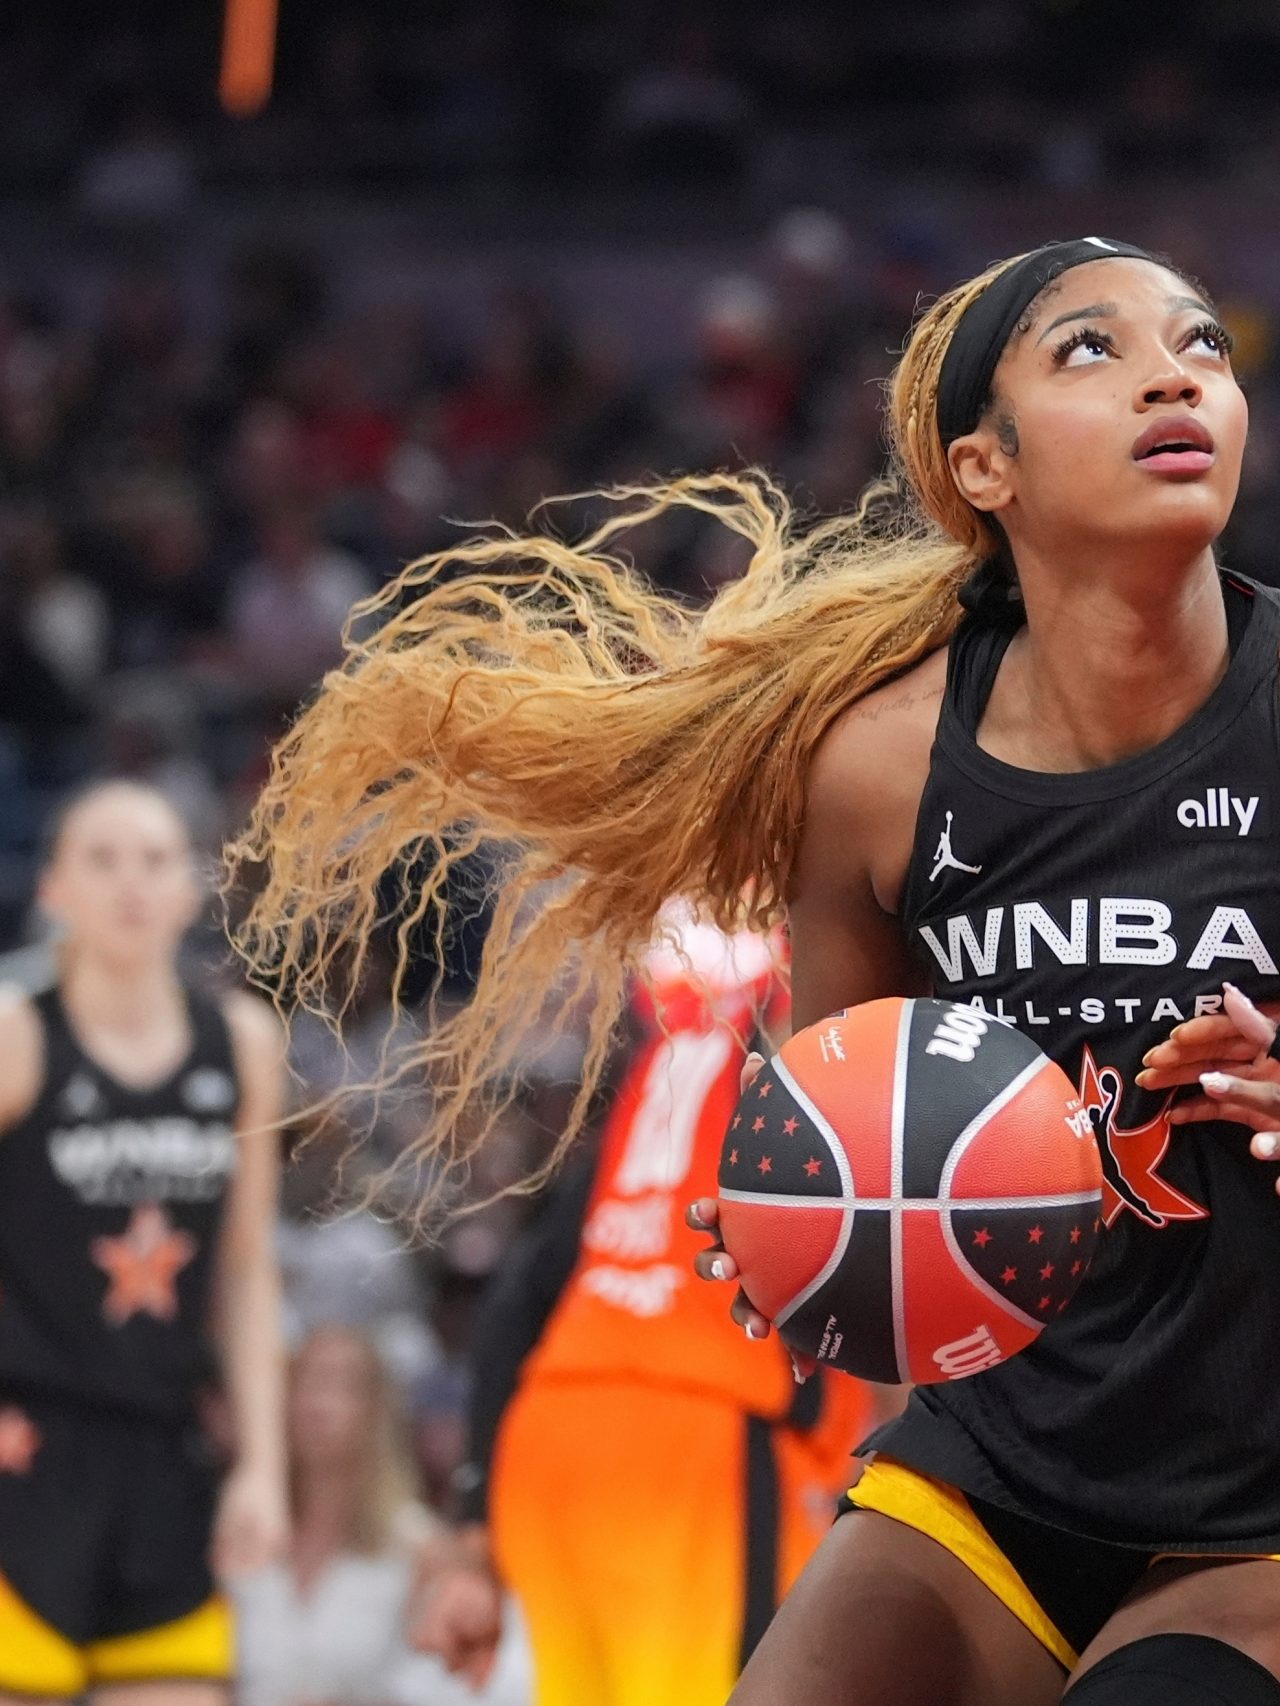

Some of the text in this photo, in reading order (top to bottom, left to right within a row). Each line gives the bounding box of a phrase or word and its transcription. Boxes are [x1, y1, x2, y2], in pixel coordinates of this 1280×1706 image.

[1177, 788, 1259, 836] ally
[917, 898, 1280, 983] WNBA
[969, 995, 1223, 1025] ALL-STAR
